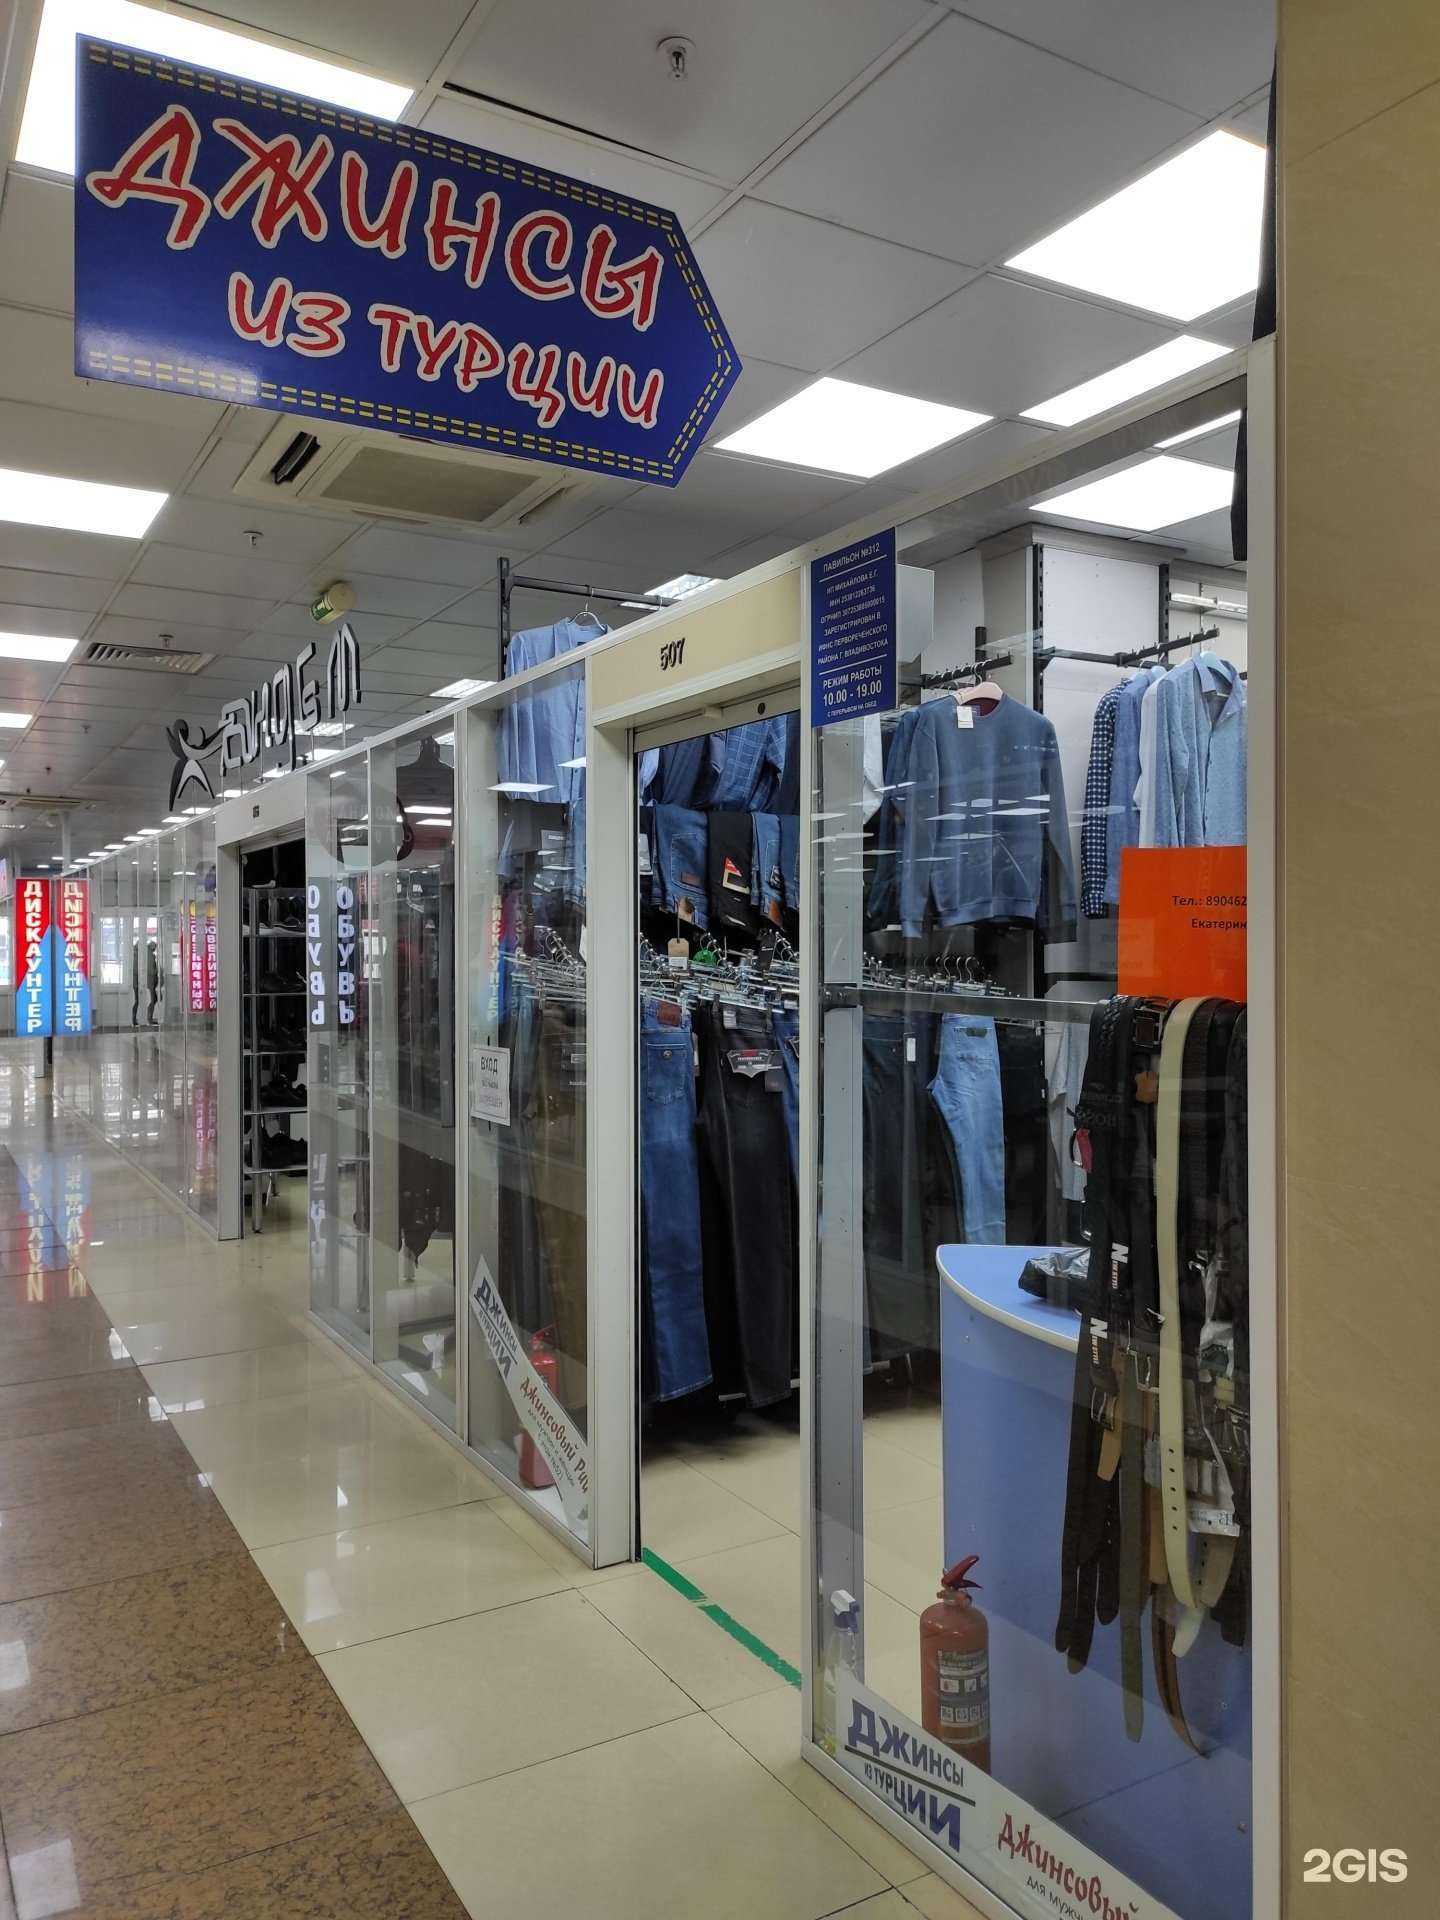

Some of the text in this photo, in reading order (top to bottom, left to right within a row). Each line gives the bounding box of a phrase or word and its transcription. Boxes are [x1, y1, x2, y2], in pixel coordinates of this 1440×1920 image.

[86, 104, 663, 331] ДЖИНСЫ
[229, 272, 663, 428] ИЗ ТУРЦИИ
[823, 542, 880, 573] ПАВИЛЬОН №312
[660, 637, 686, 671] 507
[823, 664, 882, 690] РЕЖИМ РАБОТЫ
[844, 637, 888, 658] ВЛАДИВОСТОКА
[823, 688, 847, 707] 10.00
[856, 679, 882, 698] 19.00
[1172, 895, 1202, 906] Тел.:
[24, 880, 43, 1033] ДИСКАУНТЕР
[336, 885, 355, 1024] ОБУВЬ
[520, 1376, 579, 1461] Джинсовый
[848, 1698, 964, 1788] ДЖИНСЫ
[874, 1767, 961, 1853] ТУРЦИИ
